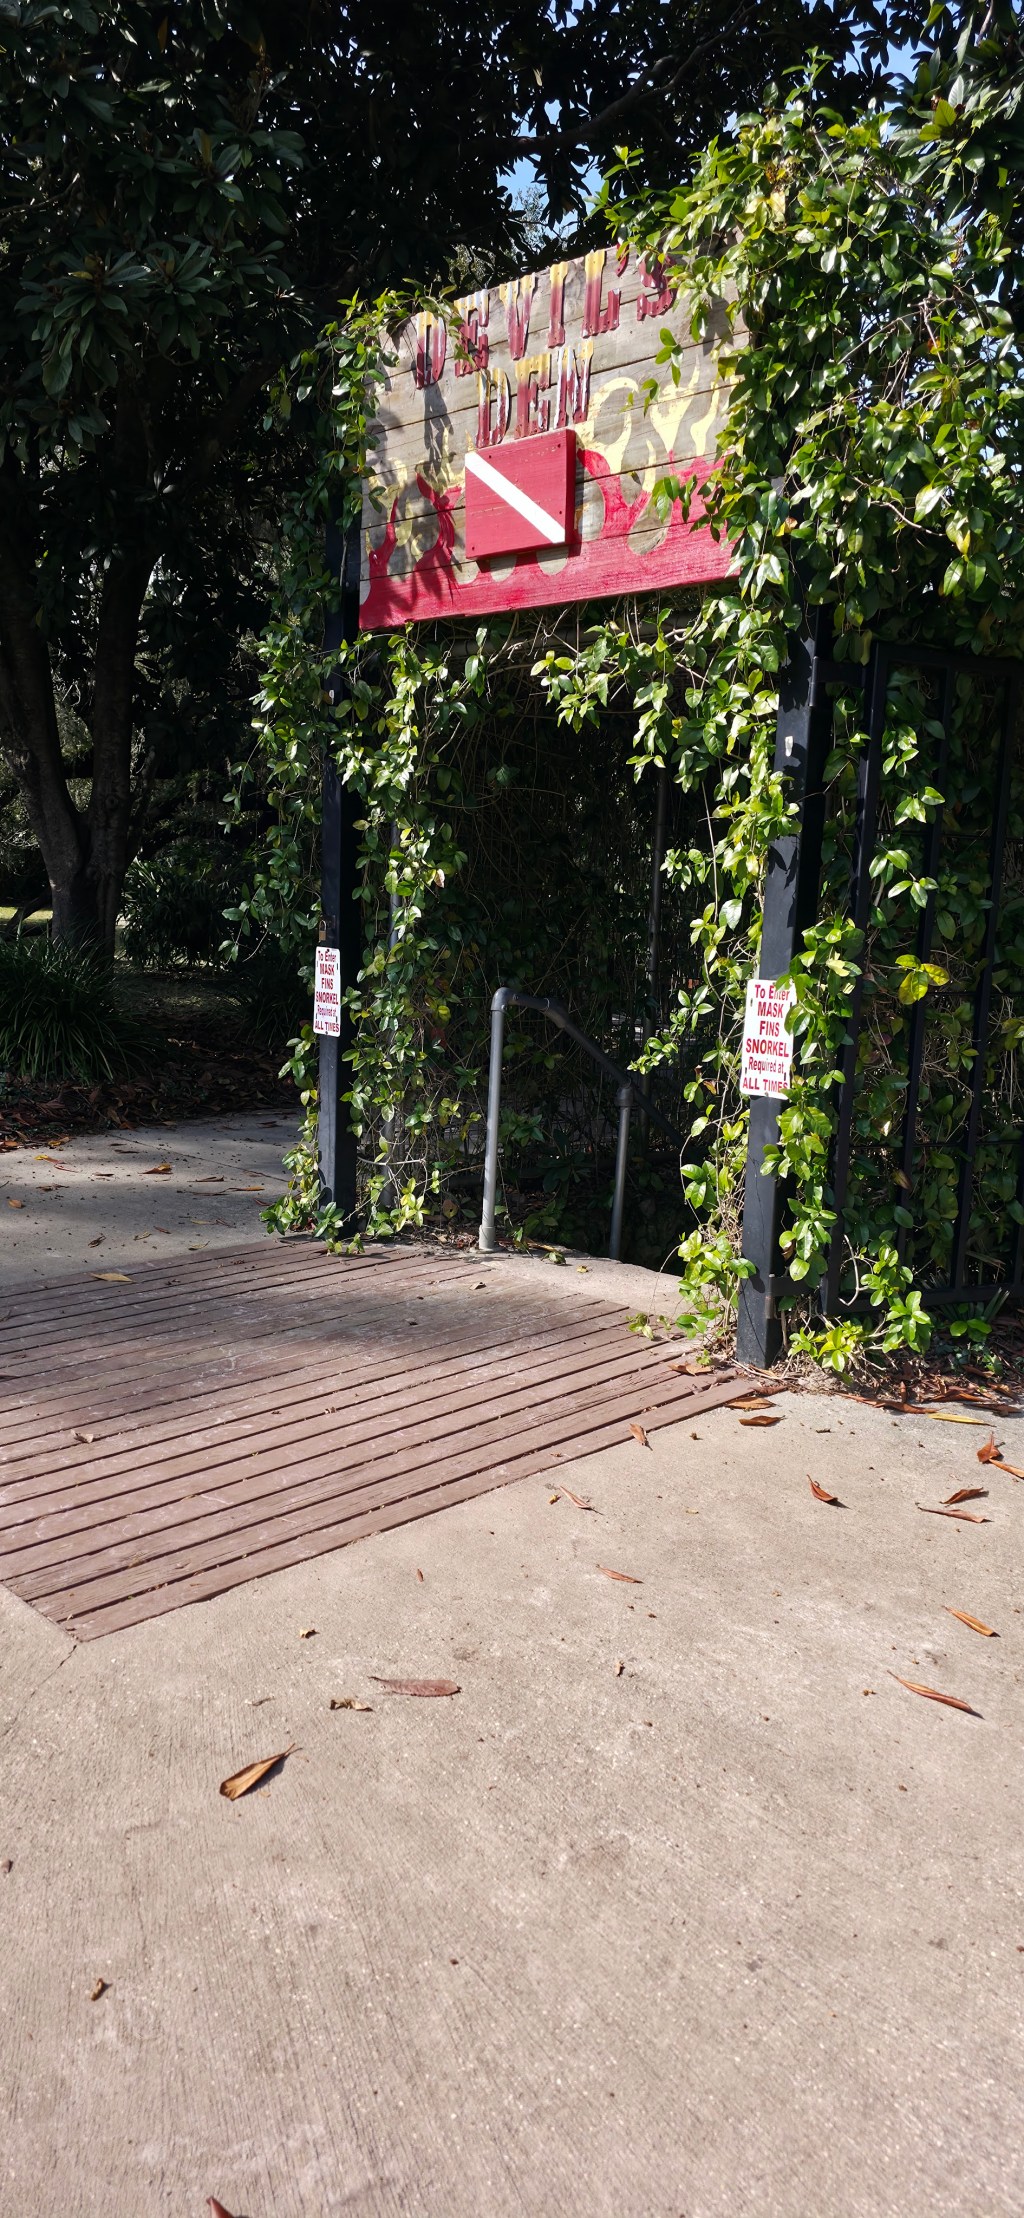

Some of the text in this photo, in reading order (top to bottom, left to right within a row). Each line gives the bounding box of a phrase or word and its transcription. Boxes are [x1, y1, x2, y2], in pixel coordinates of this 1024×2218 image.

[416, 243, 676, 389] DEVIL'S
[476, 340, 594, 448] DEN
[318, 951, 336, 962] To Enter
[320, 963, 334, 976] MASK
[321, 978, 333, 990] FINS
[316, 992, 338, 1005] SNORKEL
[755, 985, 765, 998] To
[317, 1005, 332, 1018] Required
[758, 1001, 784, 1018] MASK
[315, 1021, 339, 1032] ALL TIMES
[760, 1021, 779, 1037] FINS
[746, 1038, 789, 1058] SNORKEL
[749, 1057, 784, 1074] Required at
[743, 1077, 788, 1092] ALL TIMES
